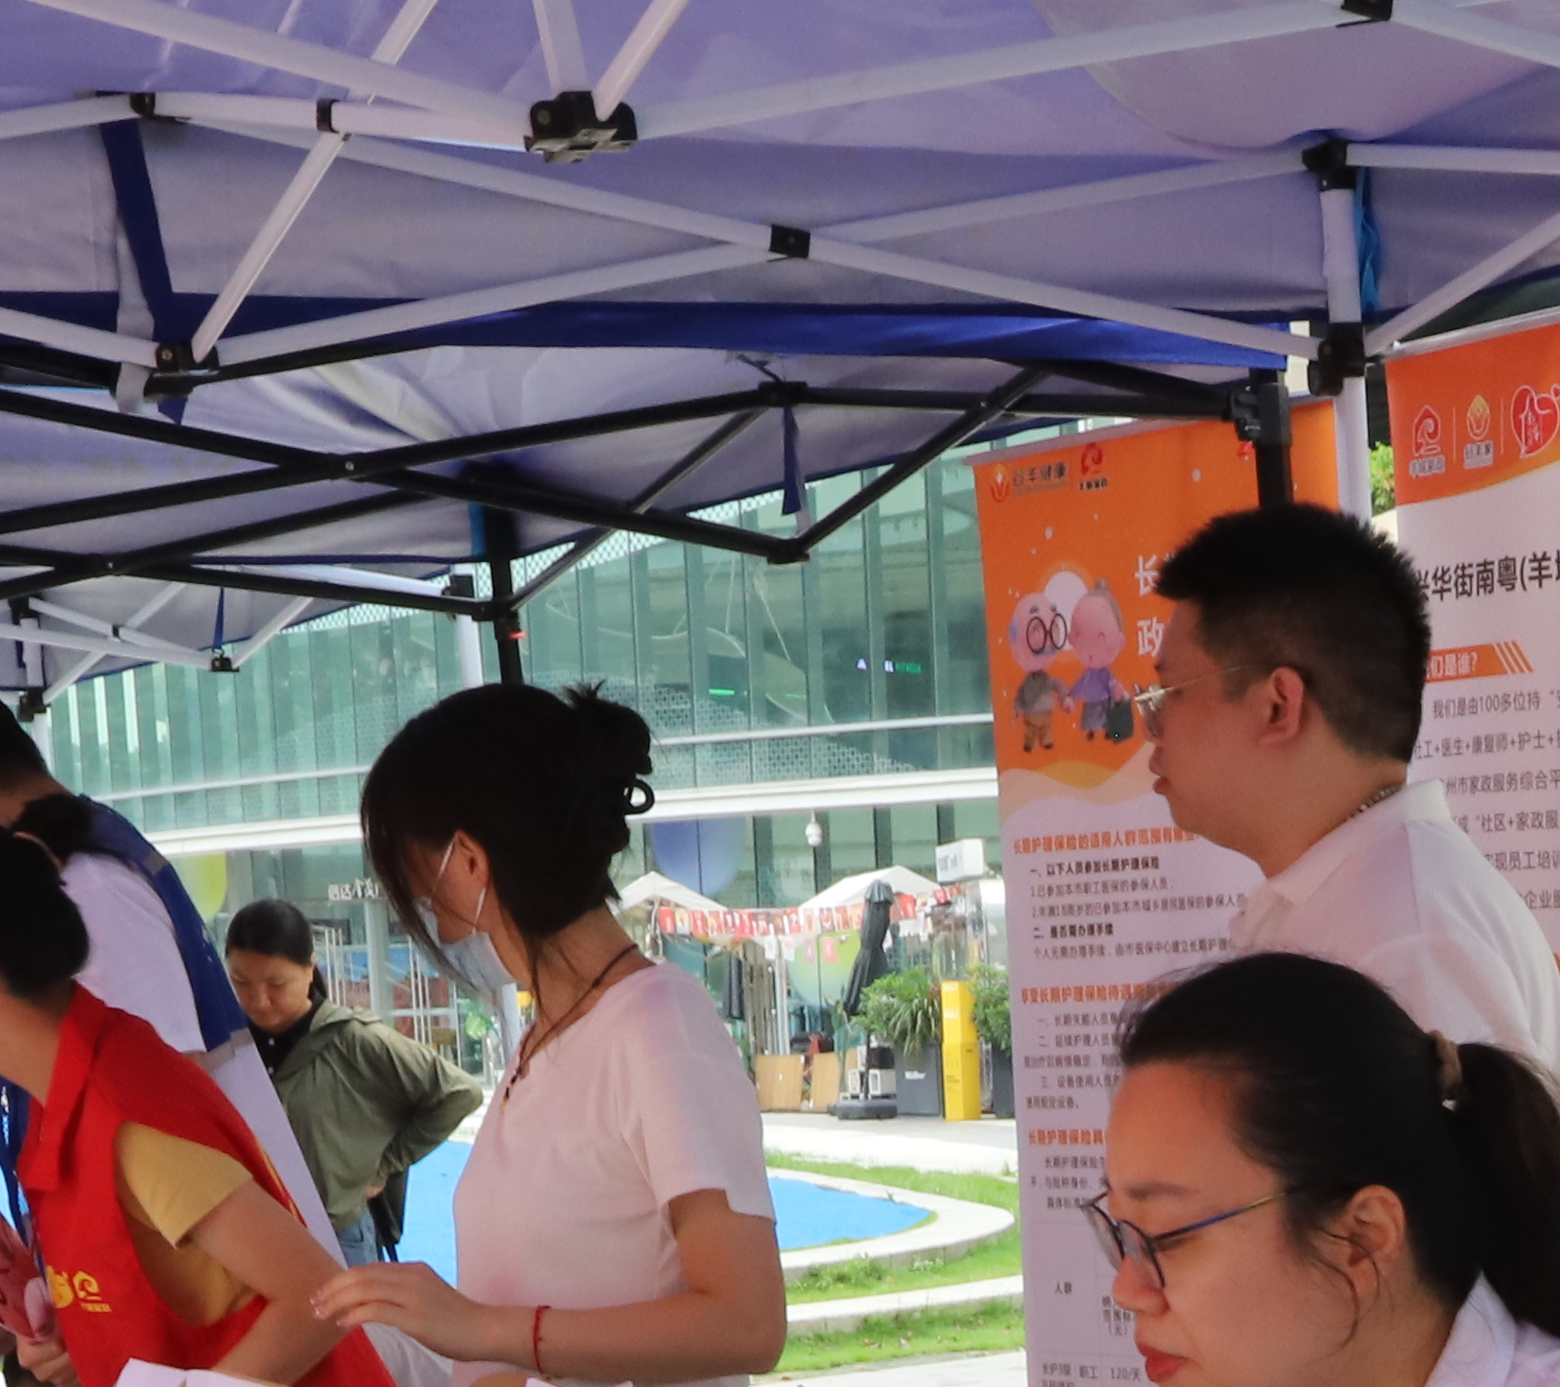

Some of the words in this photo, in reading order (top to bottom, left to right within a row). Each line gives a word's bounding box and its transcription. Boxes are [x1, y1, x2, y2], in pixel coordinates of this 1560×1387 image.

[1137, 617, 1167, 658] 政
[1427, 653, 1479, 679] 们是谁?
